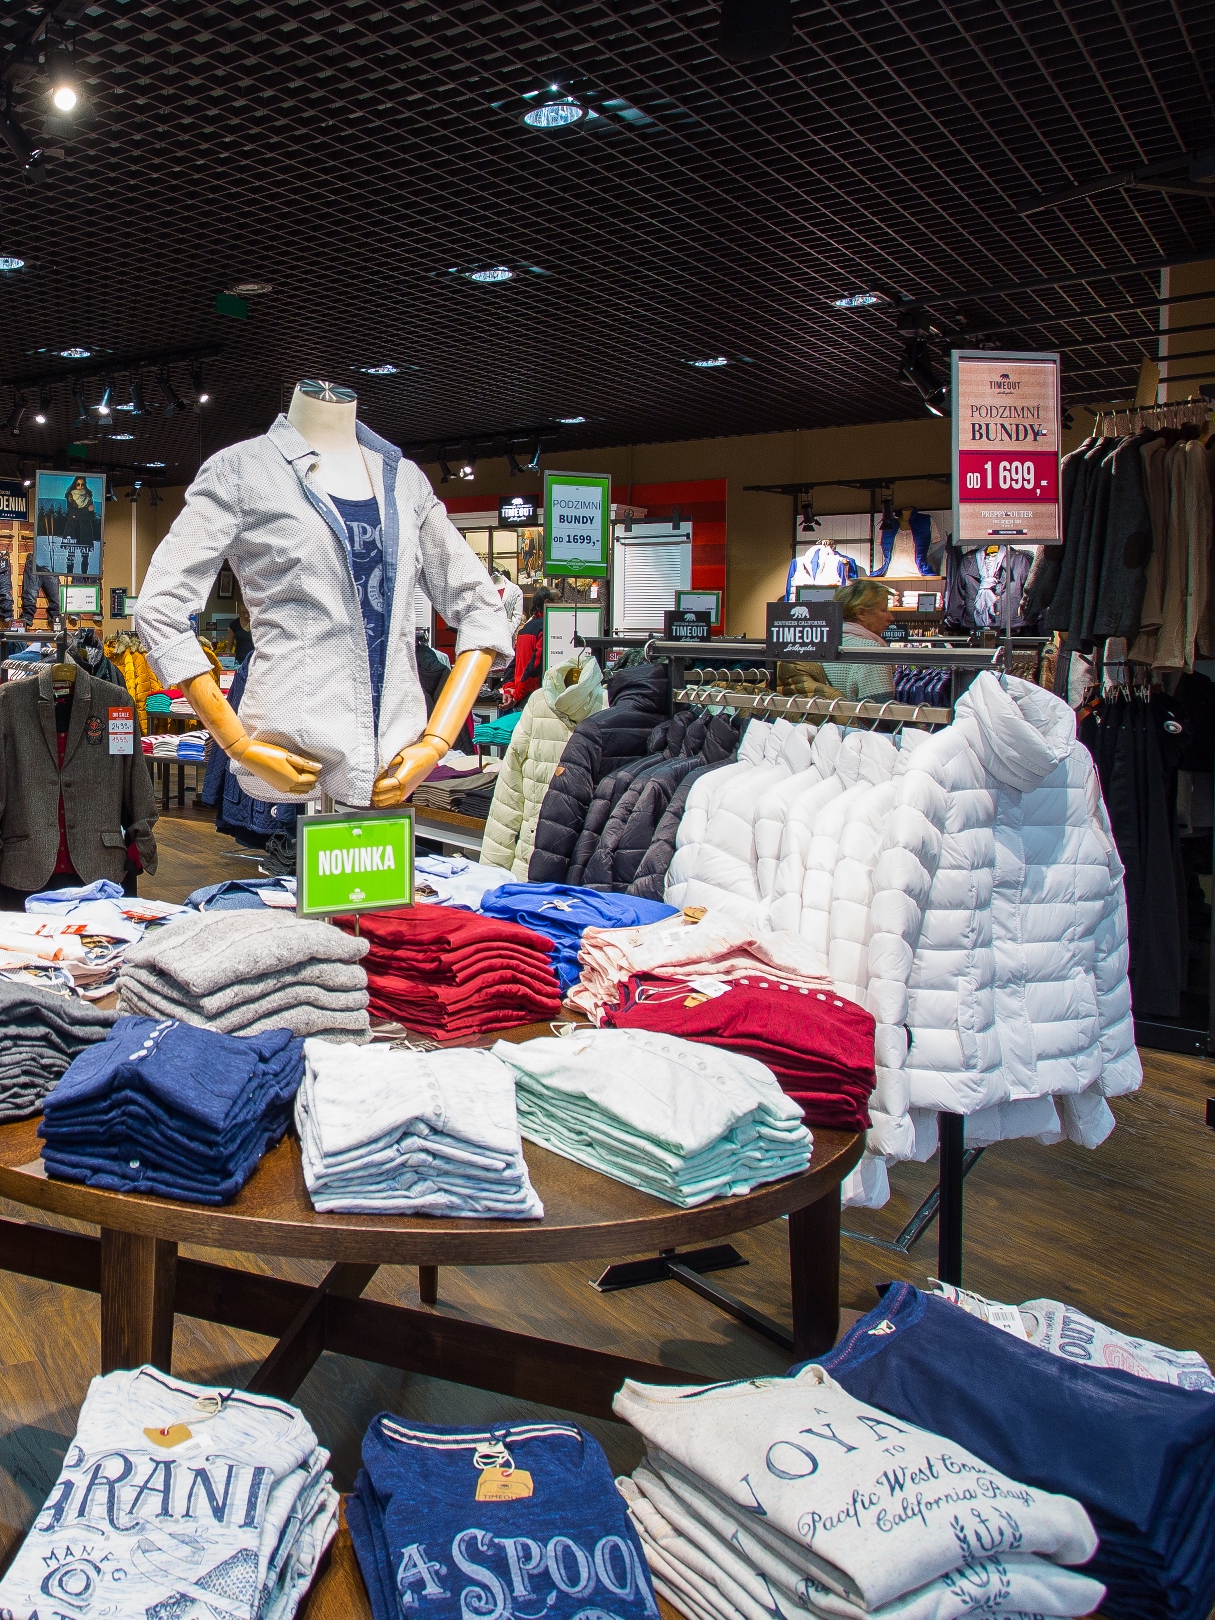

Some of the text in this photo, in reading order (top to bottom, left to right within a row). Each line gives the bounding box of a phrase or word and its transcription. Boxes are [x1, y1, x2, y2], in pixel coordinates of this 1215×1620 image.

[989, 380, 1021, 390] TIMEOUT
[970, 404, 1041, 420] PODZIMNÍ
[970, 422, 1042, 442] BUNDY
[966, 472, 981, 489] OD
[552, 499, 602, 511] PODZIMNÍ
[501, 507, 534, 517] TIMEOUT
[981, 510, 1006, 518] PREPPY
[558, 514, 595, 525] BUNDY
[566, 534, 600, 547] 1699,-
[672, 626, 708, 637] TIMEOUT
[771, 627, 829, 643] TIMEOUT
[318, 844, 395, 876] NOVINKA
[814, 1407, 828, 1415] A
[882, 1444, 906, 1457] TO
[798, 1490, 879, 1549] Pacific
[876, 1455, 940, 1498] West
[876, 1488, 977, 1533] California
[397, 1542, 451, 1598] A
